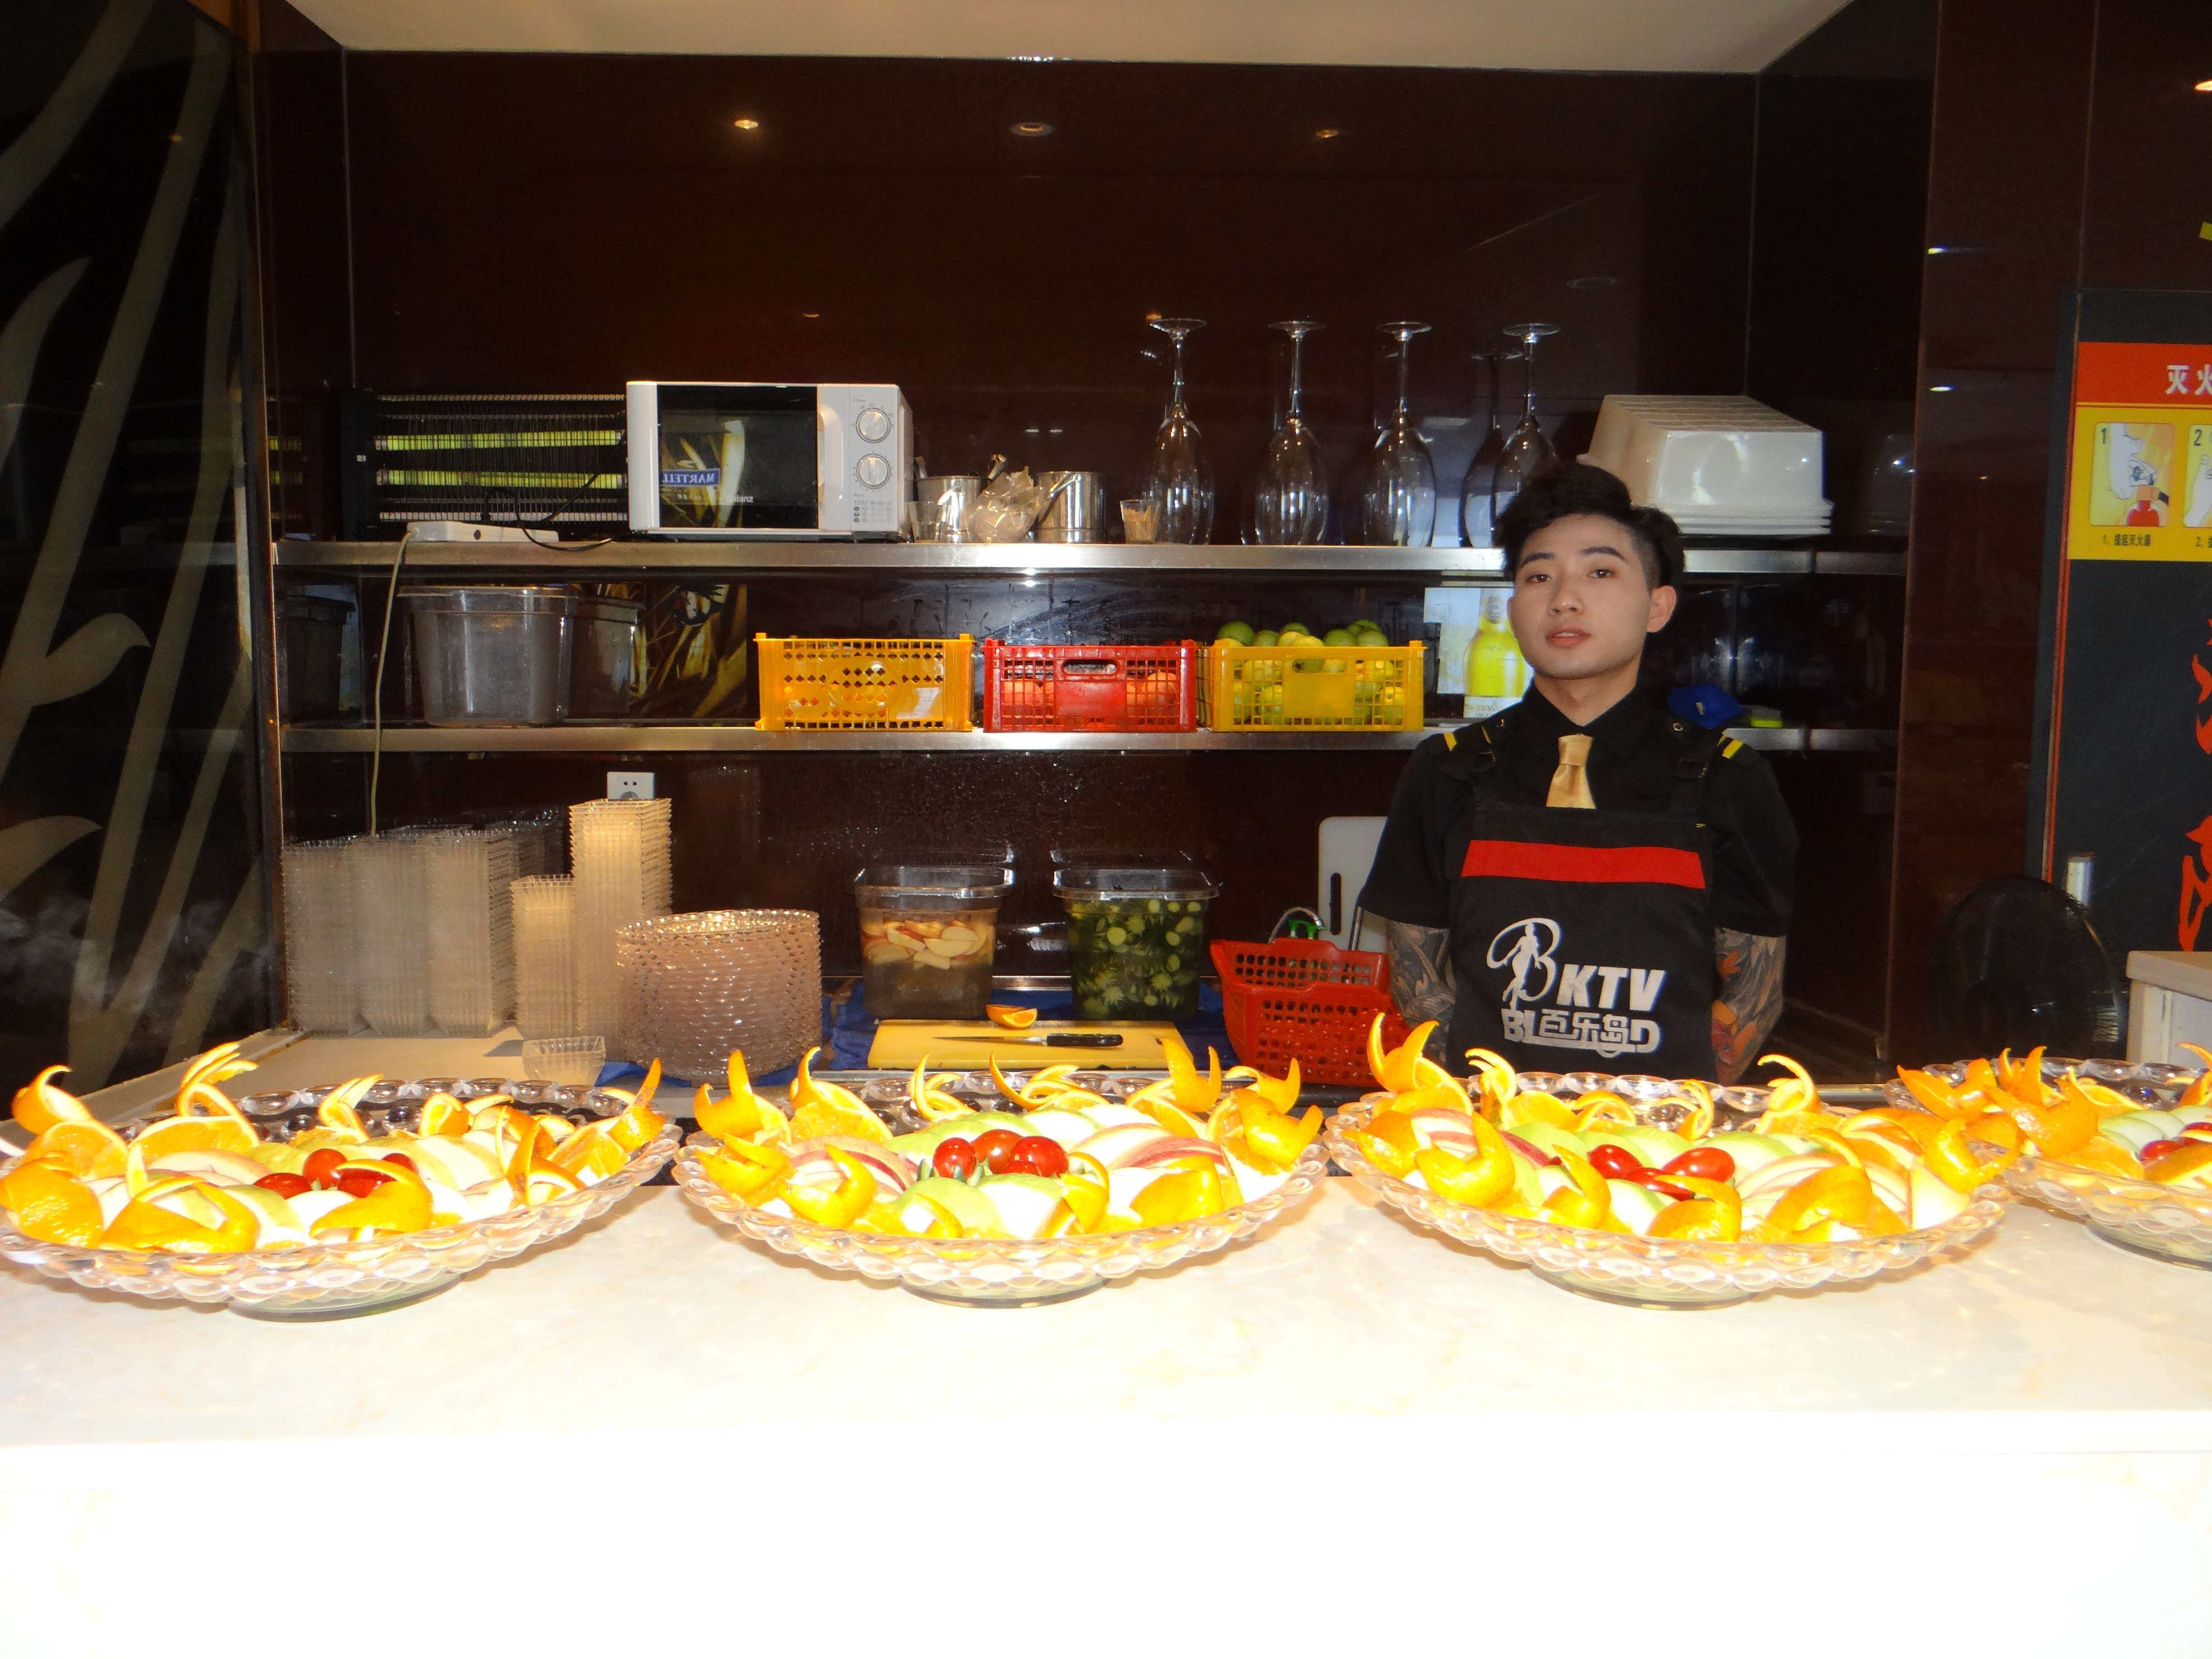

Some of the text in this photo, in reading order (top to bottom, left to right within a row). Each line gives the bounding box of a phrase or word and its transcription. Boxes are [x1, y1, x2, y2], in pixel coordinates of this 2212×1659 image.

[2165, 364, 2212, 395] 灭火
[2101, 428, 2107, 445] 1
[2193, 429, 2202, 446] 2
[1556, 964, 1665, 1012] KTV
